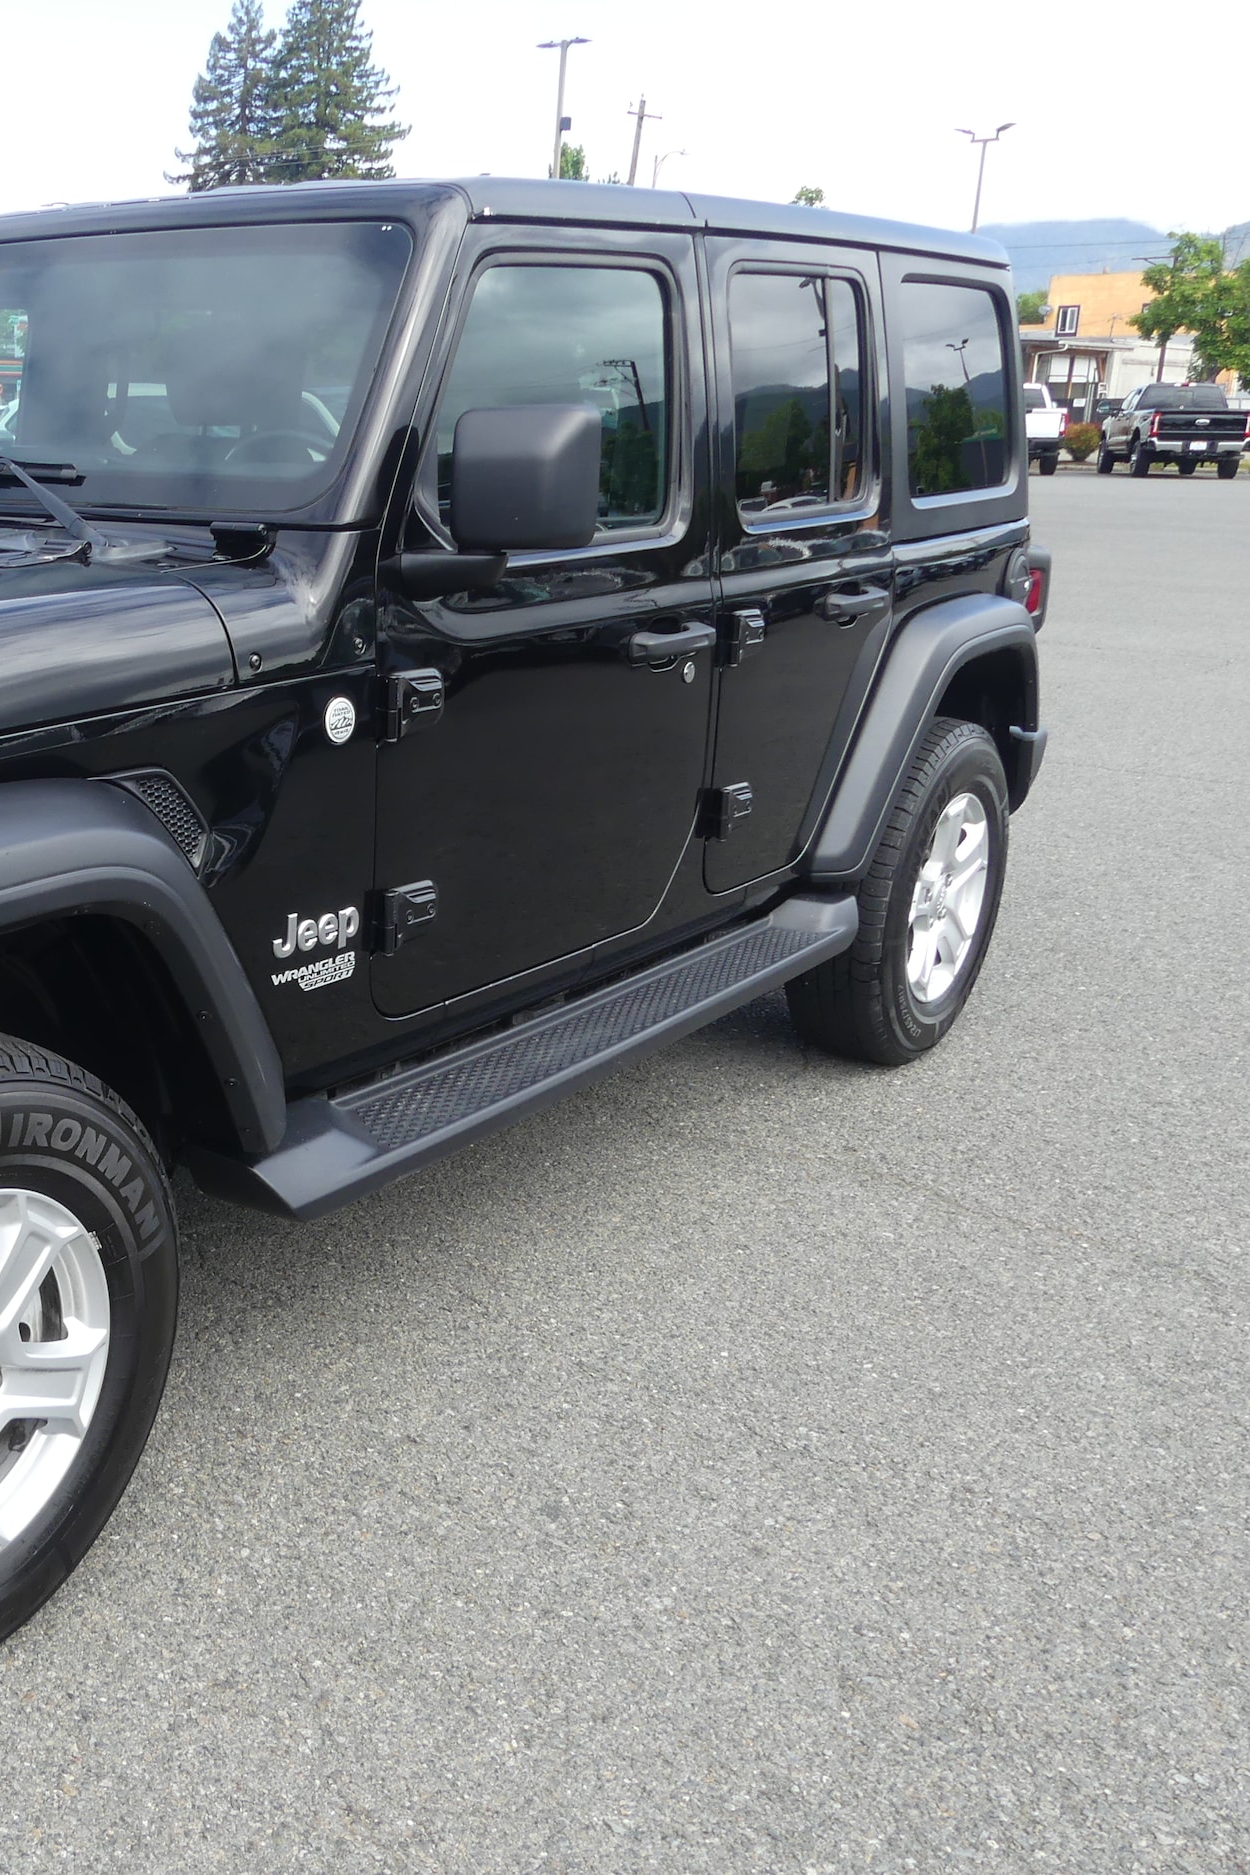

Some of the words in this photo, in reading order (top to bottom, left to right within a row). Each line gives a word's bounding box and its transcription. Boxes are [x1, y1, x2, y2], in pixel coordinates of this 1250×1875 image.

[272, 906, 360, 959] Jeep
[270, 951, 356, 986] WRANGLER
[297, 960, 356, 983] UNLIMITED
[302, 968, 354, 989] SPORT
[7, 1112, 161, 1241] IRONMAN
